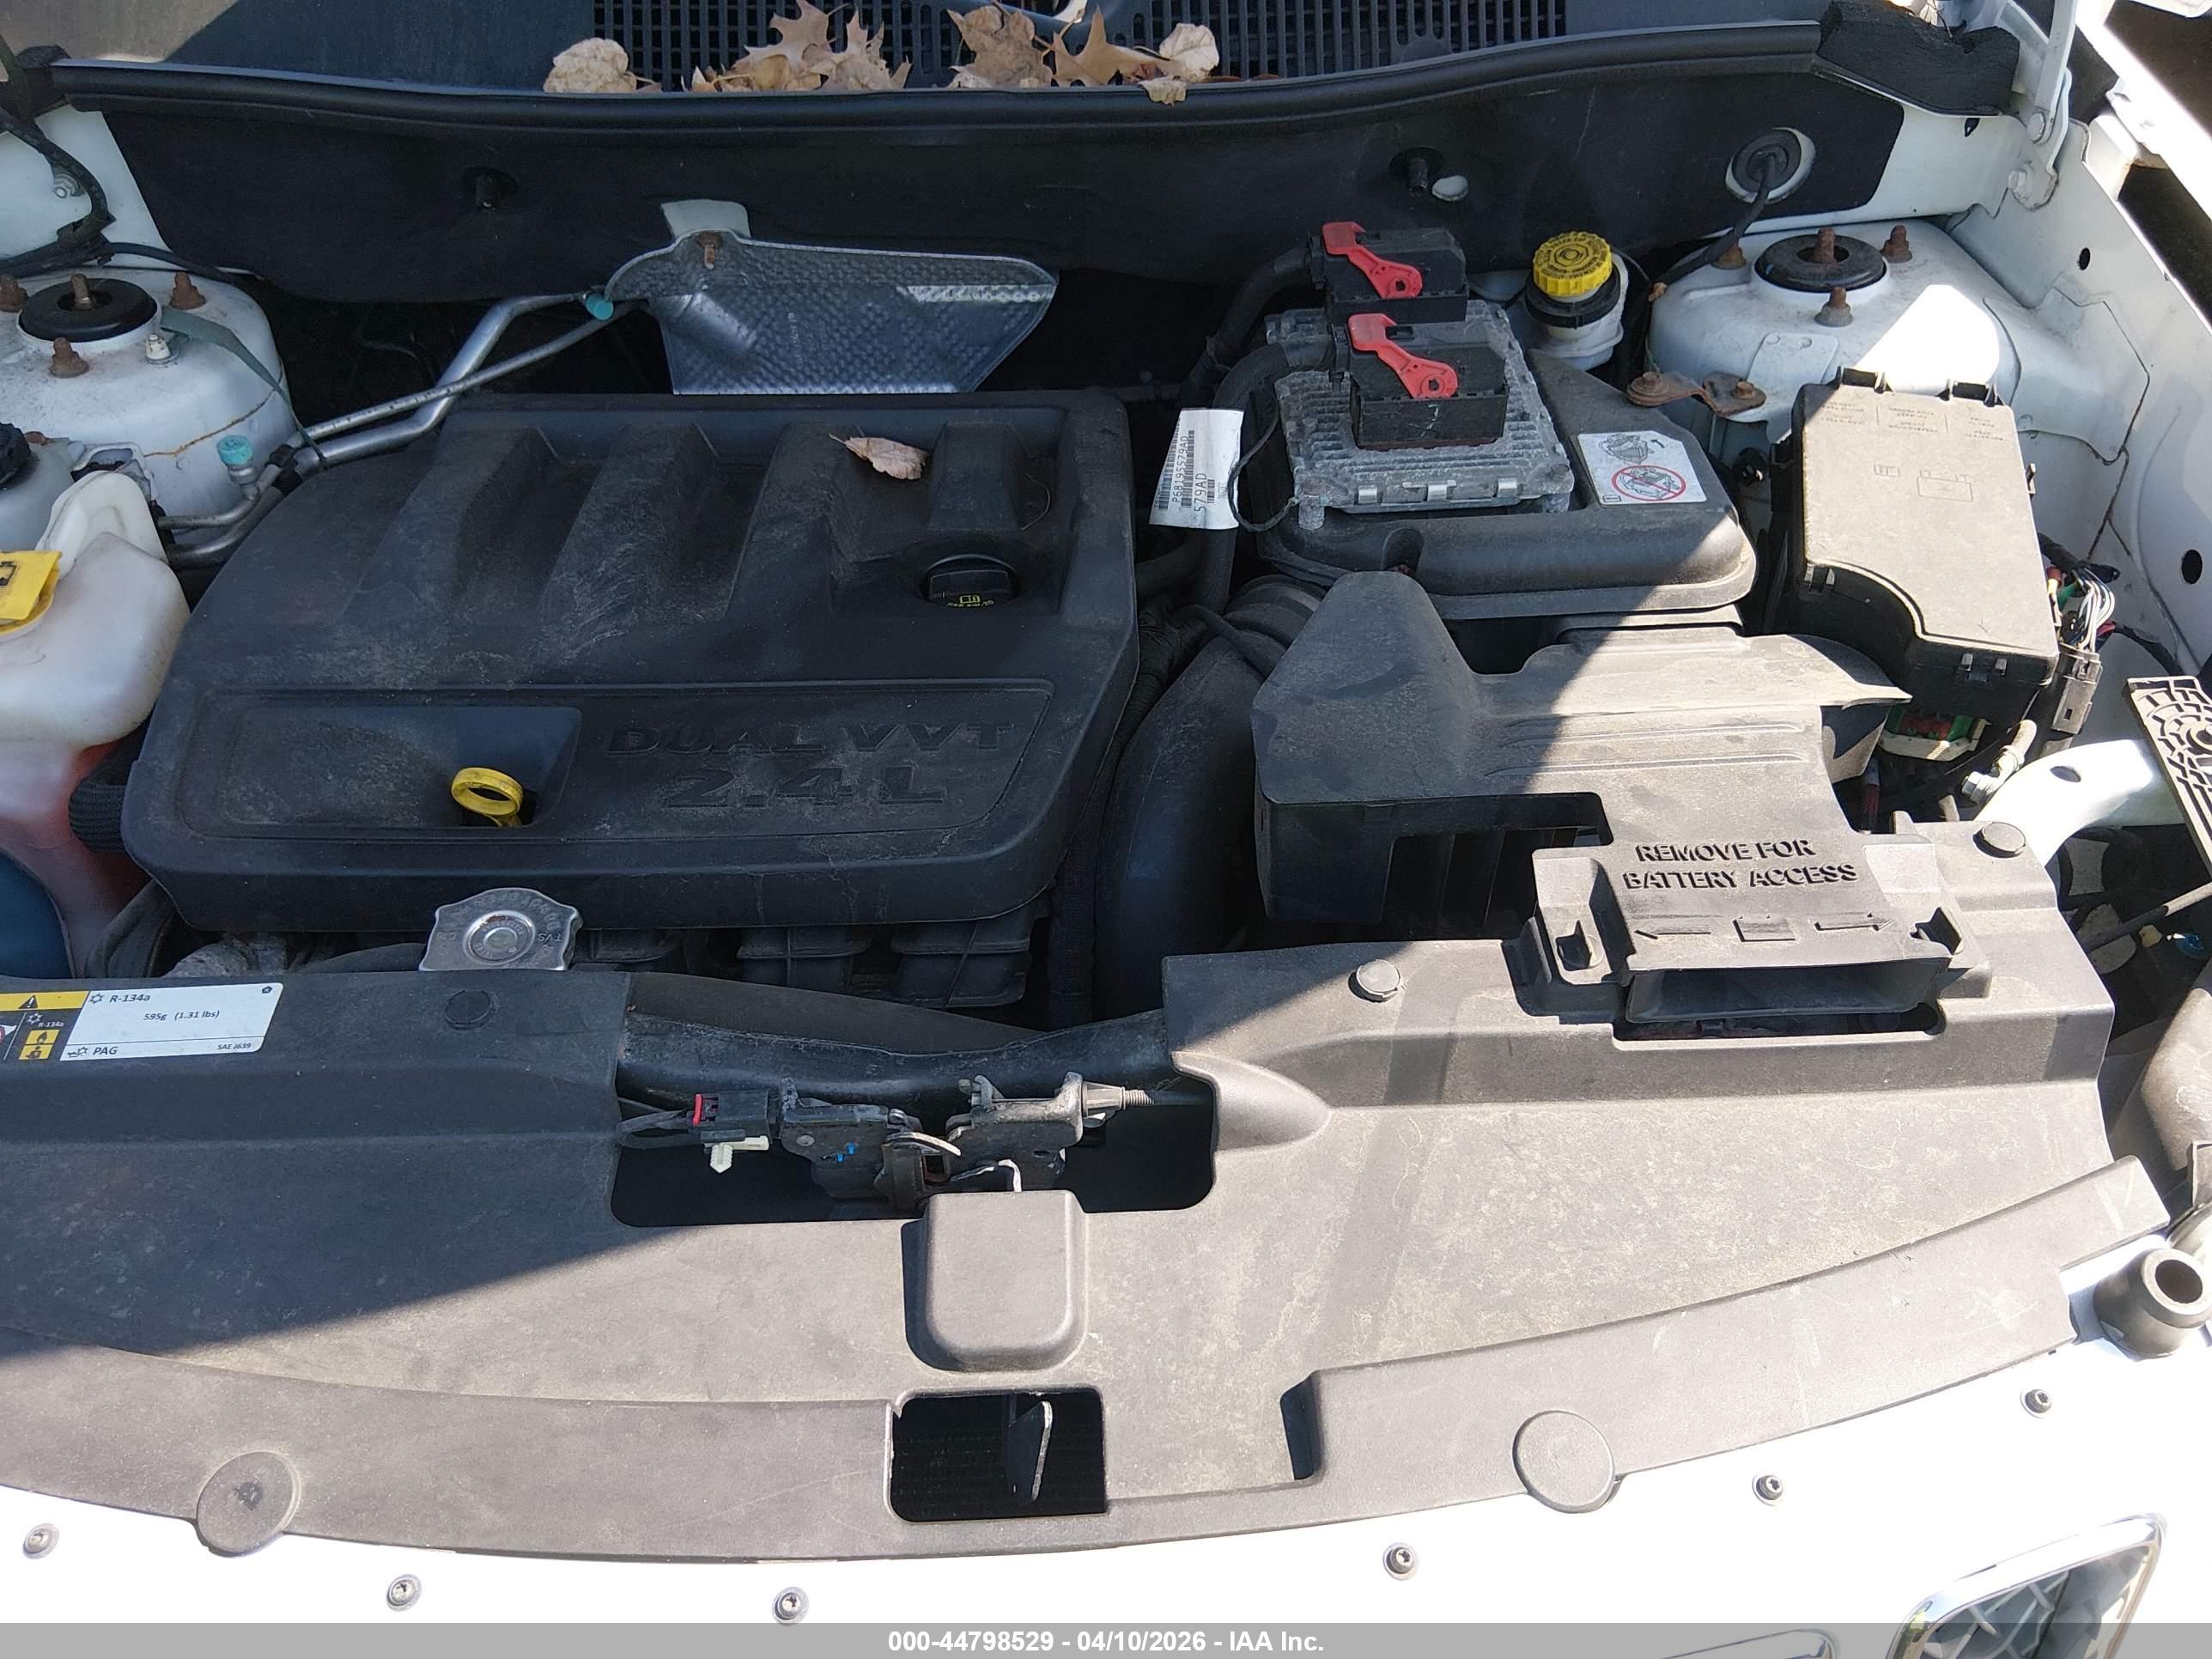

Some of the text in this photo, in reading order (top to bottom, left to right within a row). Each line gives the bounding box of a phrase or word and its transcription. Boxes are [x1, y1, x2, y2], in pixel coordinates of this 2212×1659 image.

[1171, 435, 1189, 503] P68195579AD
[1194, 472, 1207, 512] 579AD
[609, 722, 1016, 754] DUAL VVT
[665, 766, 945, 809] 2.4L
[1634, 838, 1816, 862] REMOVE FOR
[1623, 863, 1858, 889] BATTERY ACCESS
[537, 933, 562, 942] TVS
[109, 994, 151, 1003] R-134a
[143, 1010, 220, 1021] 595g (1.31 lbs)
[93, 1046, 118, 1055] PAG
